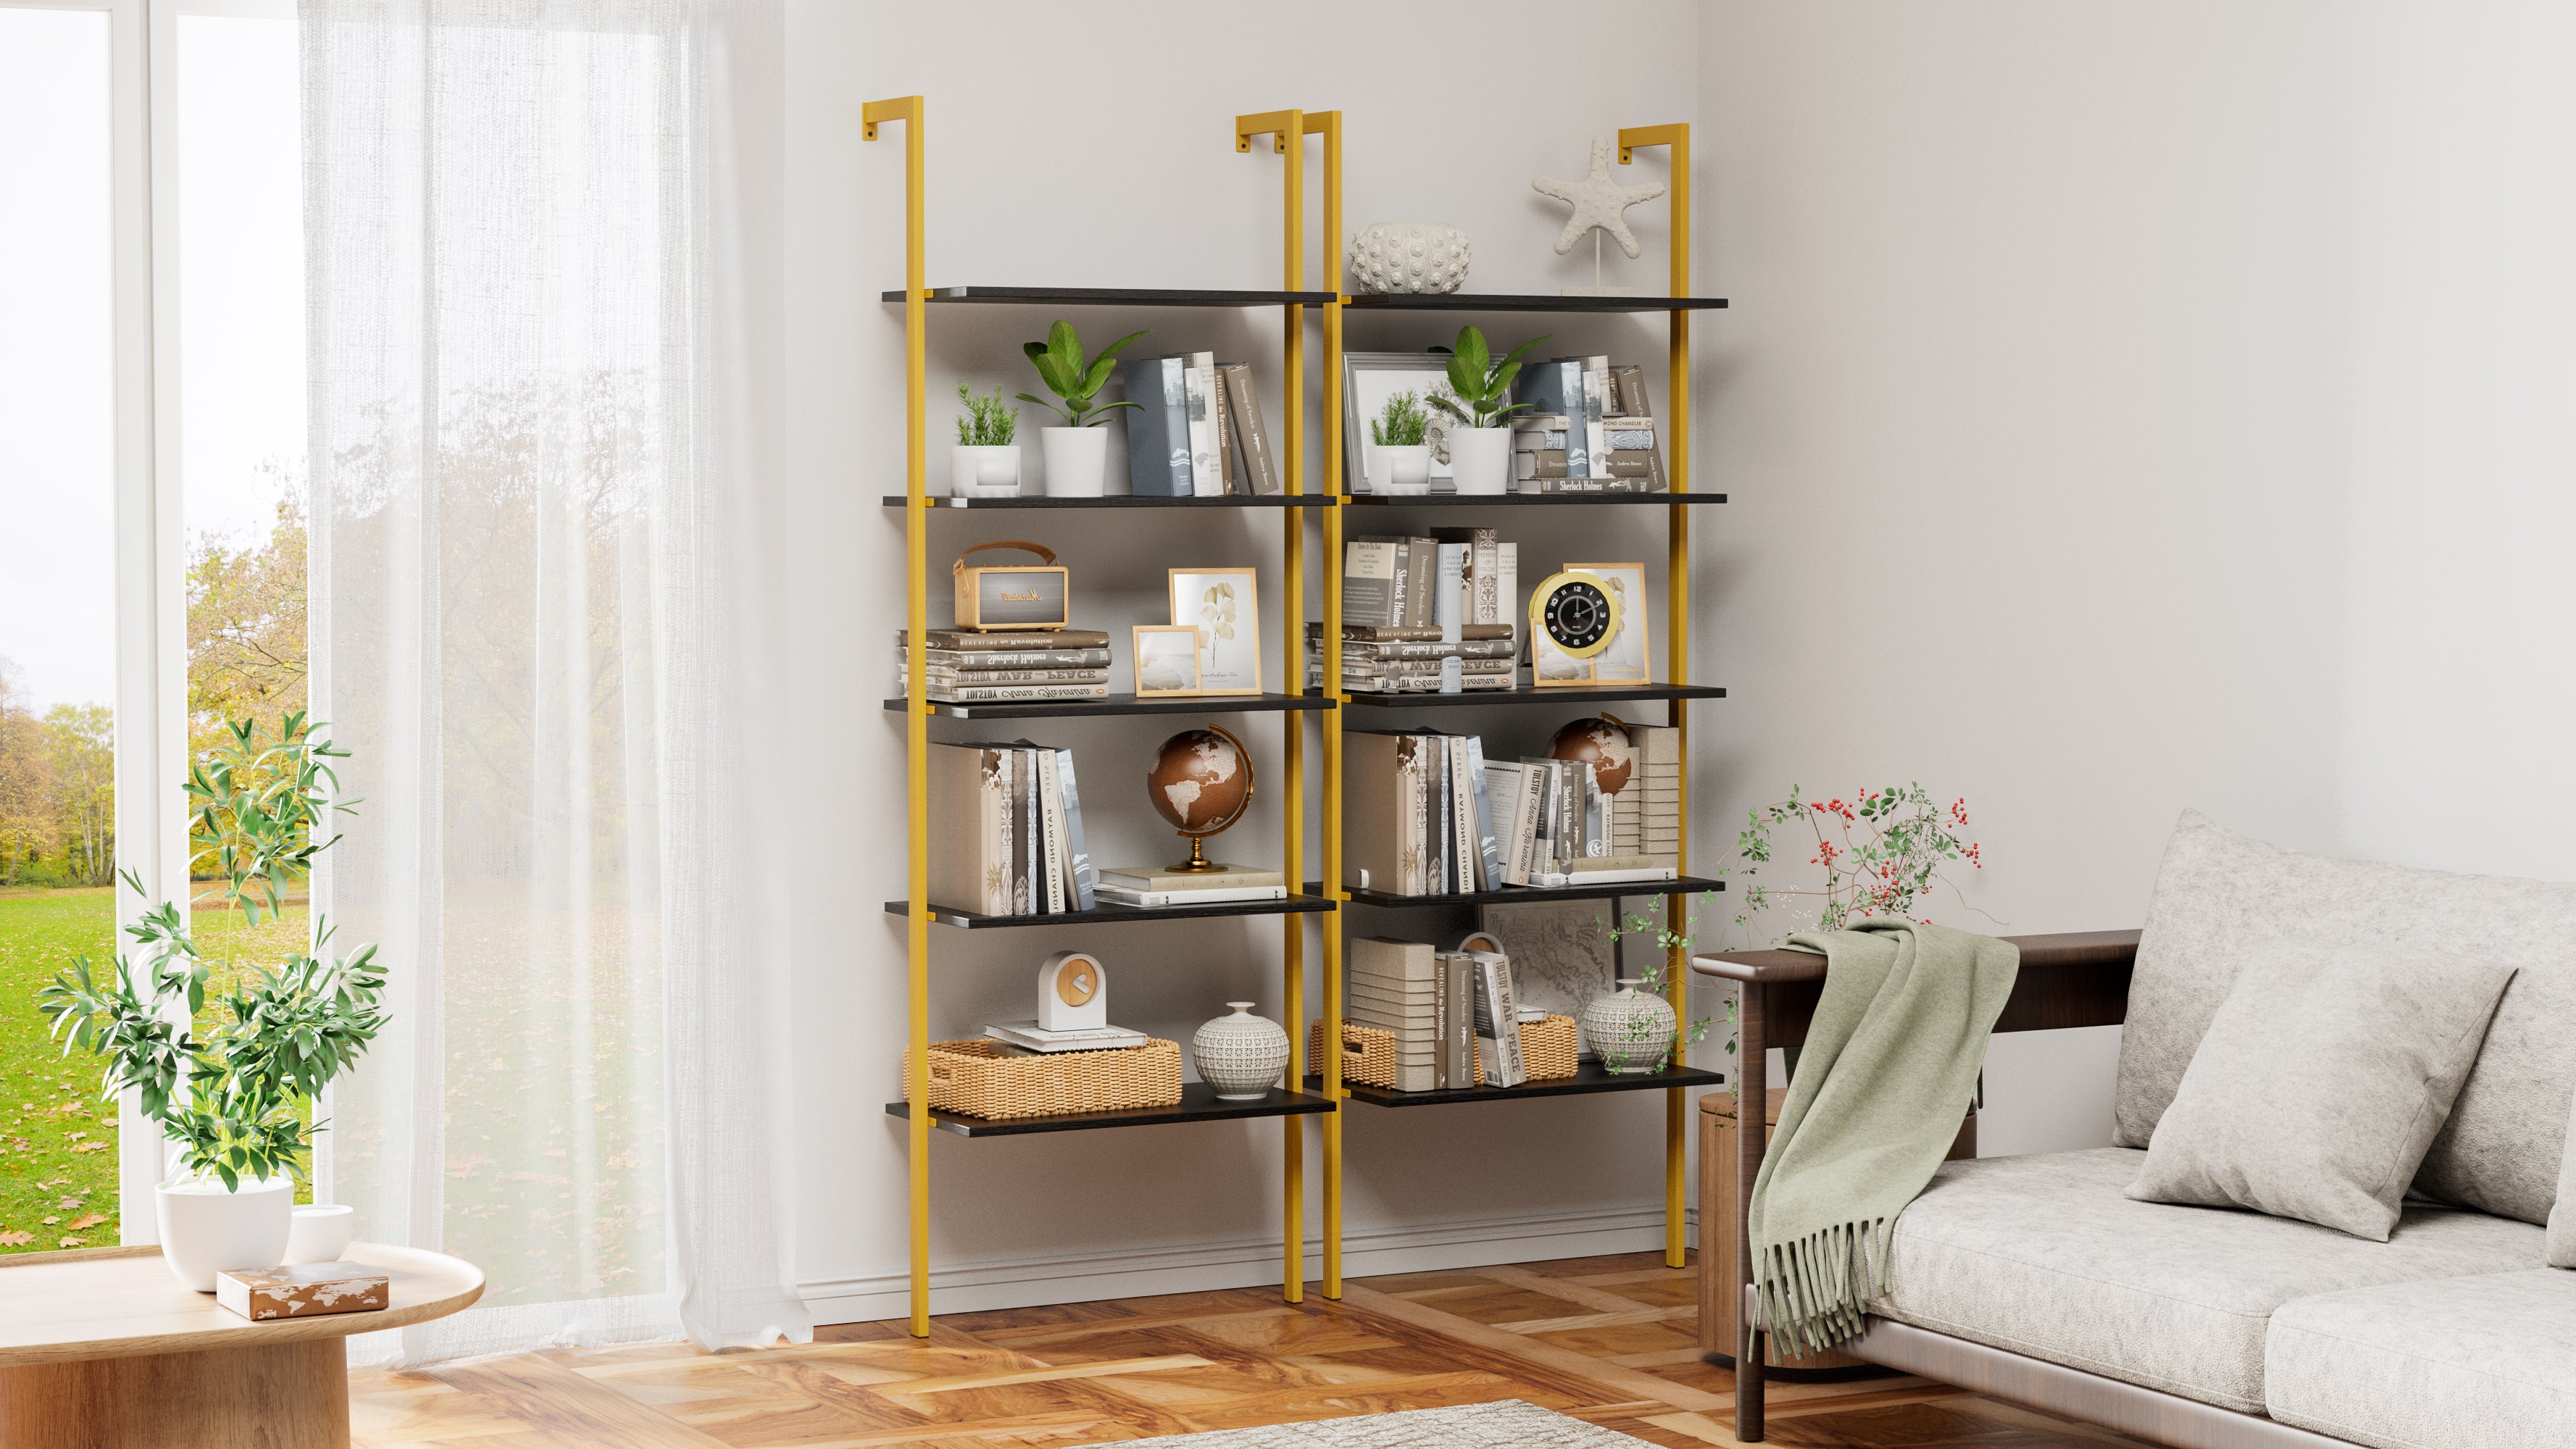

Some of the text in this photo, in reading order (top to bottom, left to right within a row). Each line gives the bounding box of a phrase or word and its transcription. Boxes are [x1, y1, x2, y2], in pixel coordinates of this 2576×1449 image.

[1241, 380, 1249, 404] Dreaming
[1632, 383, 1641, 406] Dreaming
[1559, 481, 1603, 490] Sherlock Holmes
[1420, 555, 1429, 584] Dreaming
[1393, 569, 1407, 627] Sherlock Holmes
[1551, 598, 1559, 607] 10
[1530, 769, 1542, 796] TOLSTOY
[1527, 798, 1536, 824] Anna
[1520, 827, 1532, 872] Karenina
[1496, 961, 1509, 988] TOLSTOY
[1501, 993, 1513, 1023] WAR
[1507, 1032, 1520, 1072] PEACE
